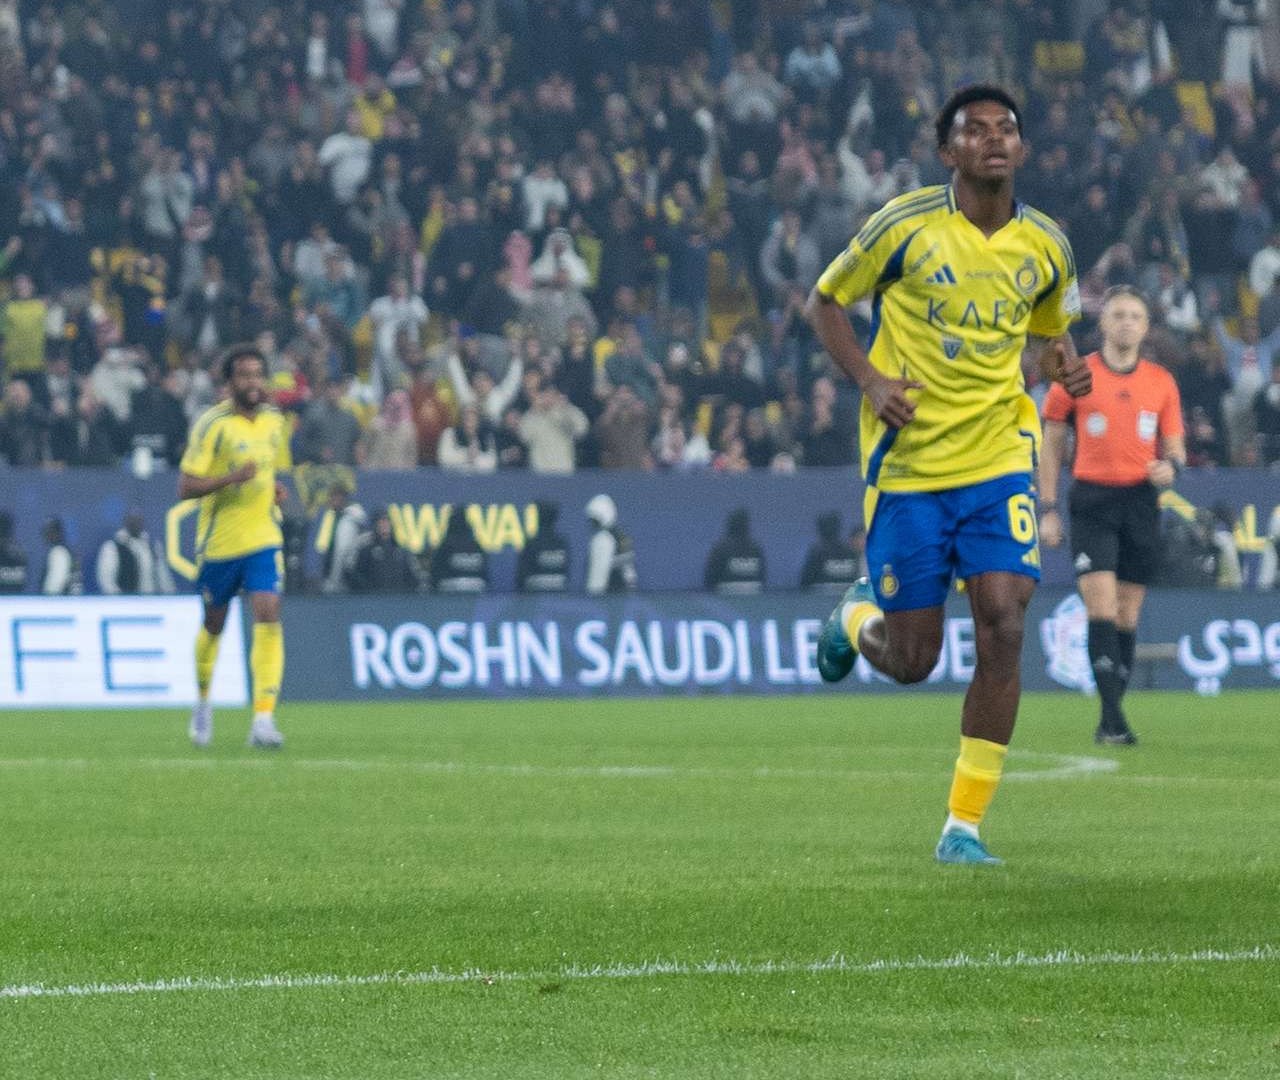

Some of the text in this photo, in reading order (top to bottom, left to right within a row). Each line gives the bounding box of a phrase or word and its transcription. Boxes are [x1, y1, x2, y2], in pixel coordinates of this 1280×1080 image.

[1008, 493, 1038, 544] 6
[351, 621, 562, 689] ROSHN
[576, 619, 752, 687] SAUDI
